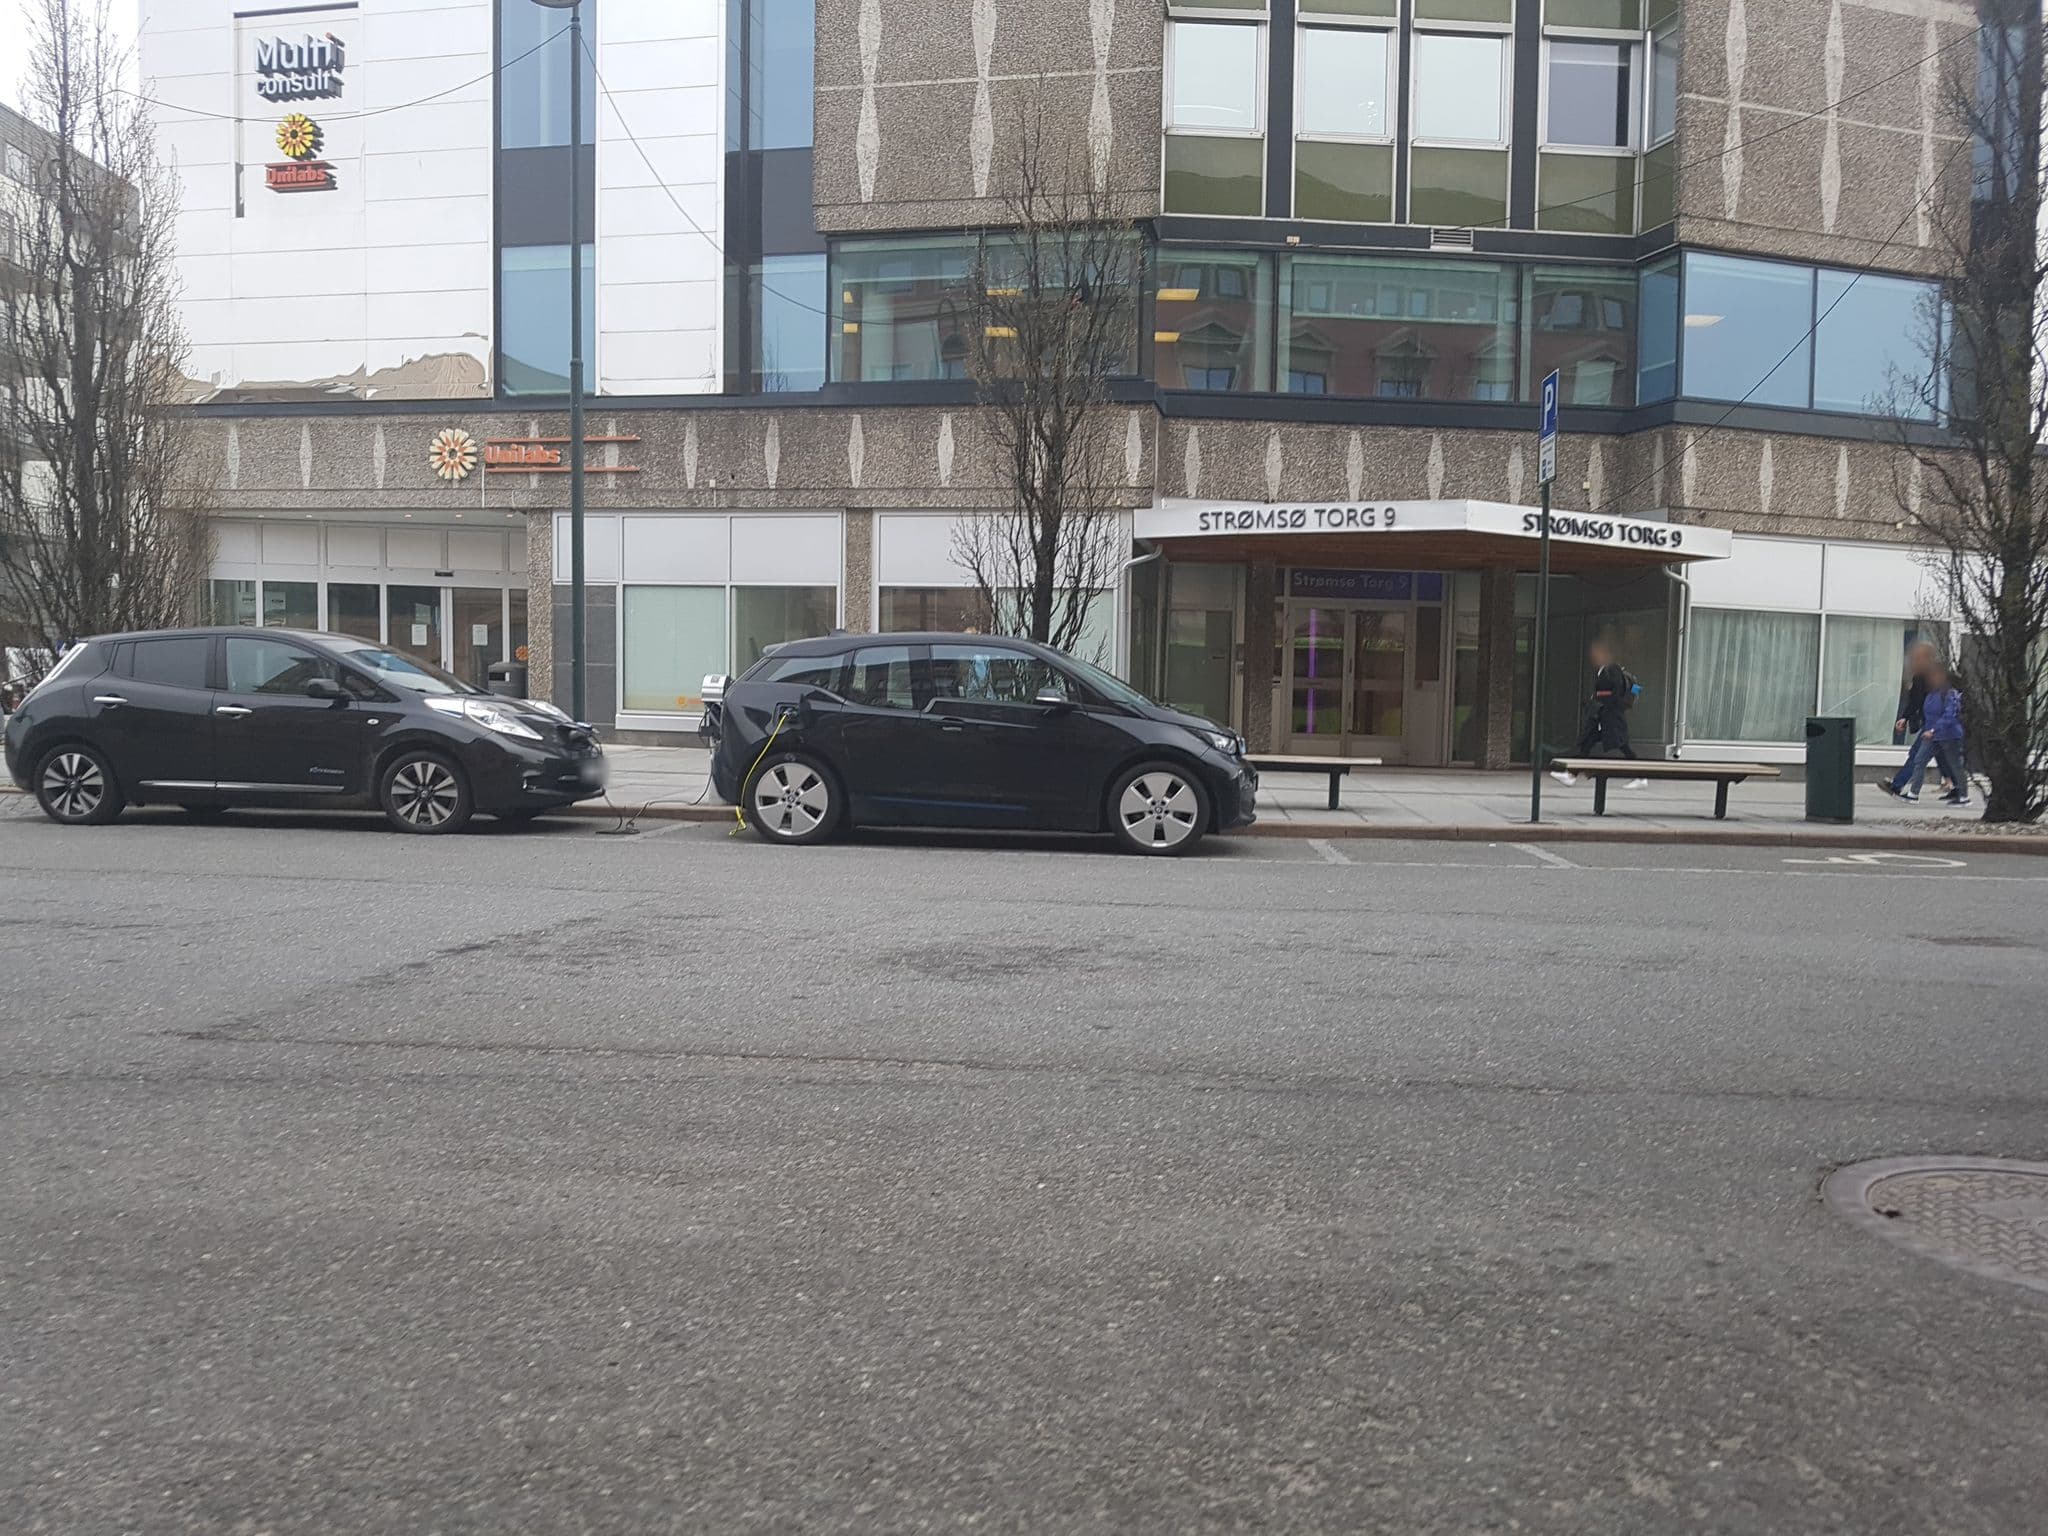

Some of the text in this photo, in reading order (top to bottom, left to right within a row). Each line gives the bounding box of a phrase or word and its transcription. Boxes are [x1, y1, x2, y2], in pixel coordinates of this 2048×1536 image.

[255, 33, 335, 71] Multi
[255, 68, 331, 95] consult
[265, 166, 326, 184] Unilabs
[1543, 383, 1554, 431] P
[485, 444, 561, 463] Unilabs
[1199, 507, 1396, 531] STRØMSØ TORG 9
[1617, 523, 1667, 546] TORG
[1671, 530, 1682, 548] 9
